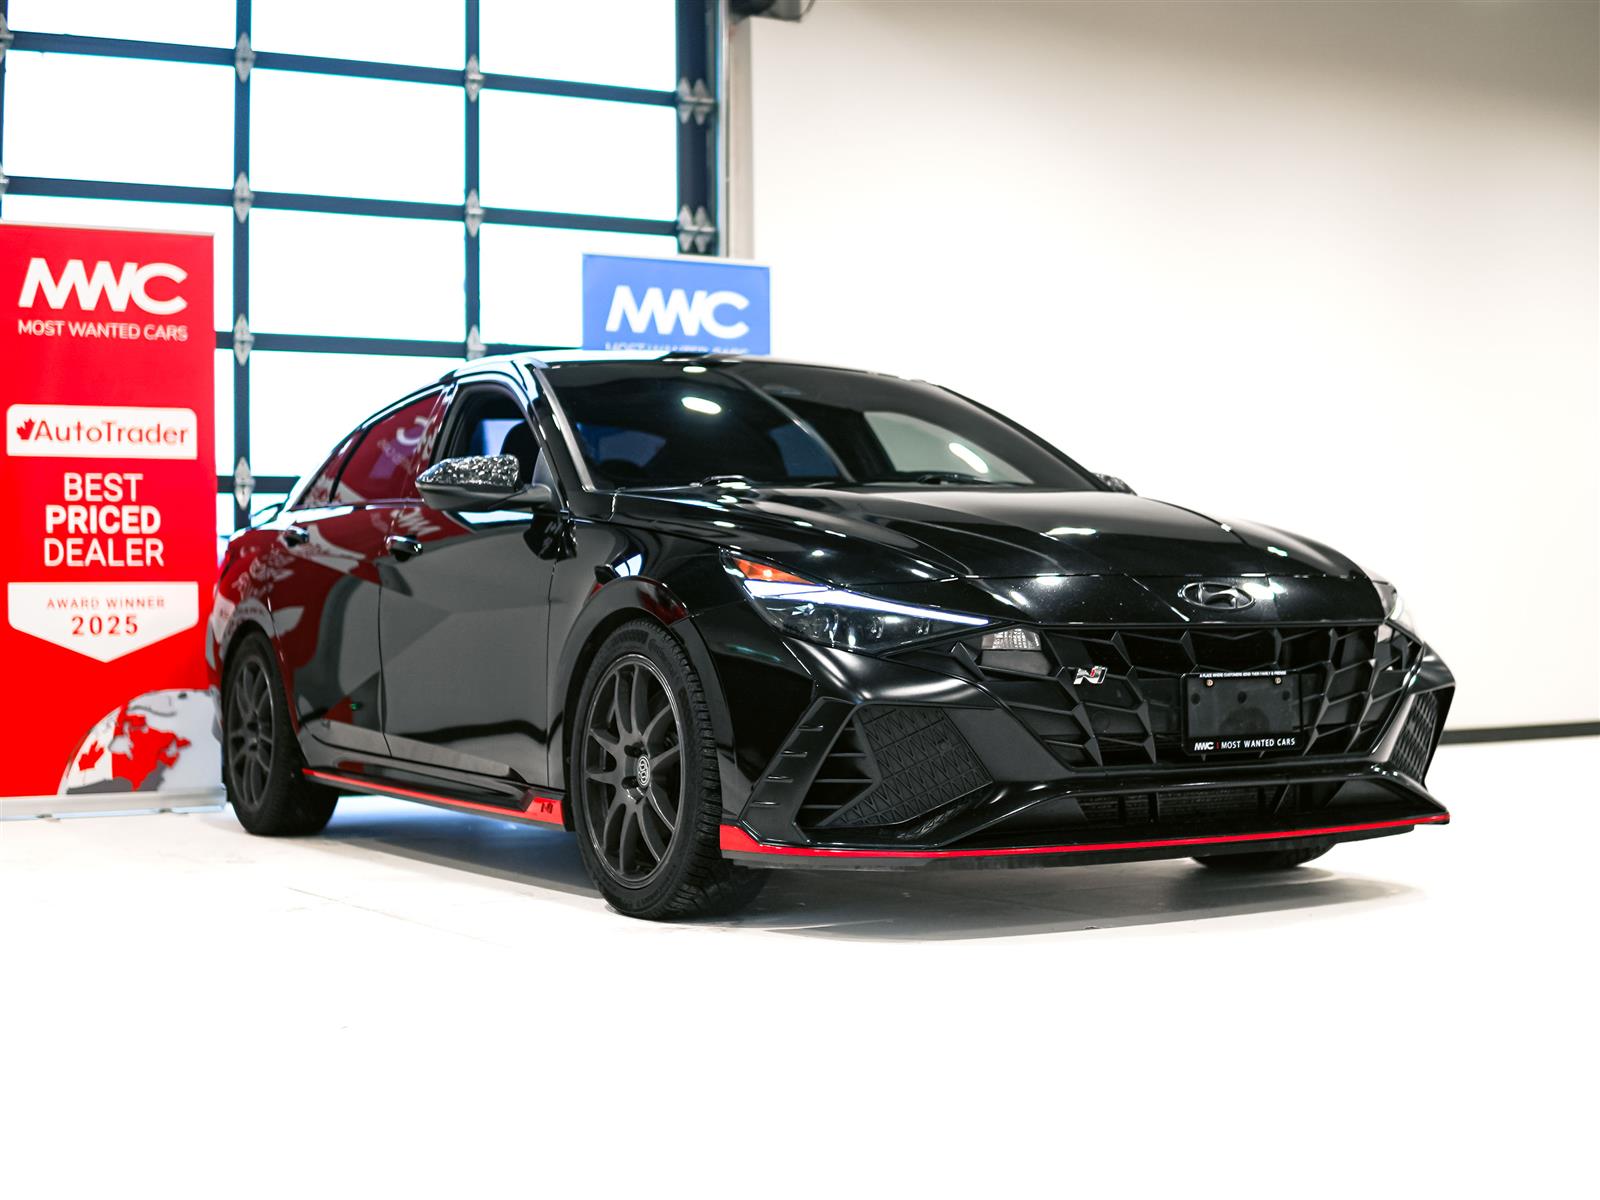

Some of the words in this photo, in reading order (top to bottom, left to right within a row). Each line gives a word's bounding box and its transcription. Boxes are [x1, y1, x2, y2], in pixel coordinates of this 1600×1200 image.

[18, 257, 188, 315] MWC
[605, 284, 749, 339] MWC
[18, 319, 65, 336] MOST
[68, 321, 141, 340] WANTED
[143, 324, 188, 342] CARS
[35, 419, 188, 445] AutoTrader
[63, 472, 144, 502] BEST
[45, 504, 162, 534] PRICED
[43, 537, 165, 567] DEALER
[46, 597, 100, 610] AWARD
[105, 596, 166, 608] WINNER
[71, 614, 139, 636] 2025
[1194, 742, 1214, 751] MWC
[1221, 740, 1241, 749] MOST
[1244, 739, 1275, 748] WANTED
[1276, 738, 1296, 746] CARS
